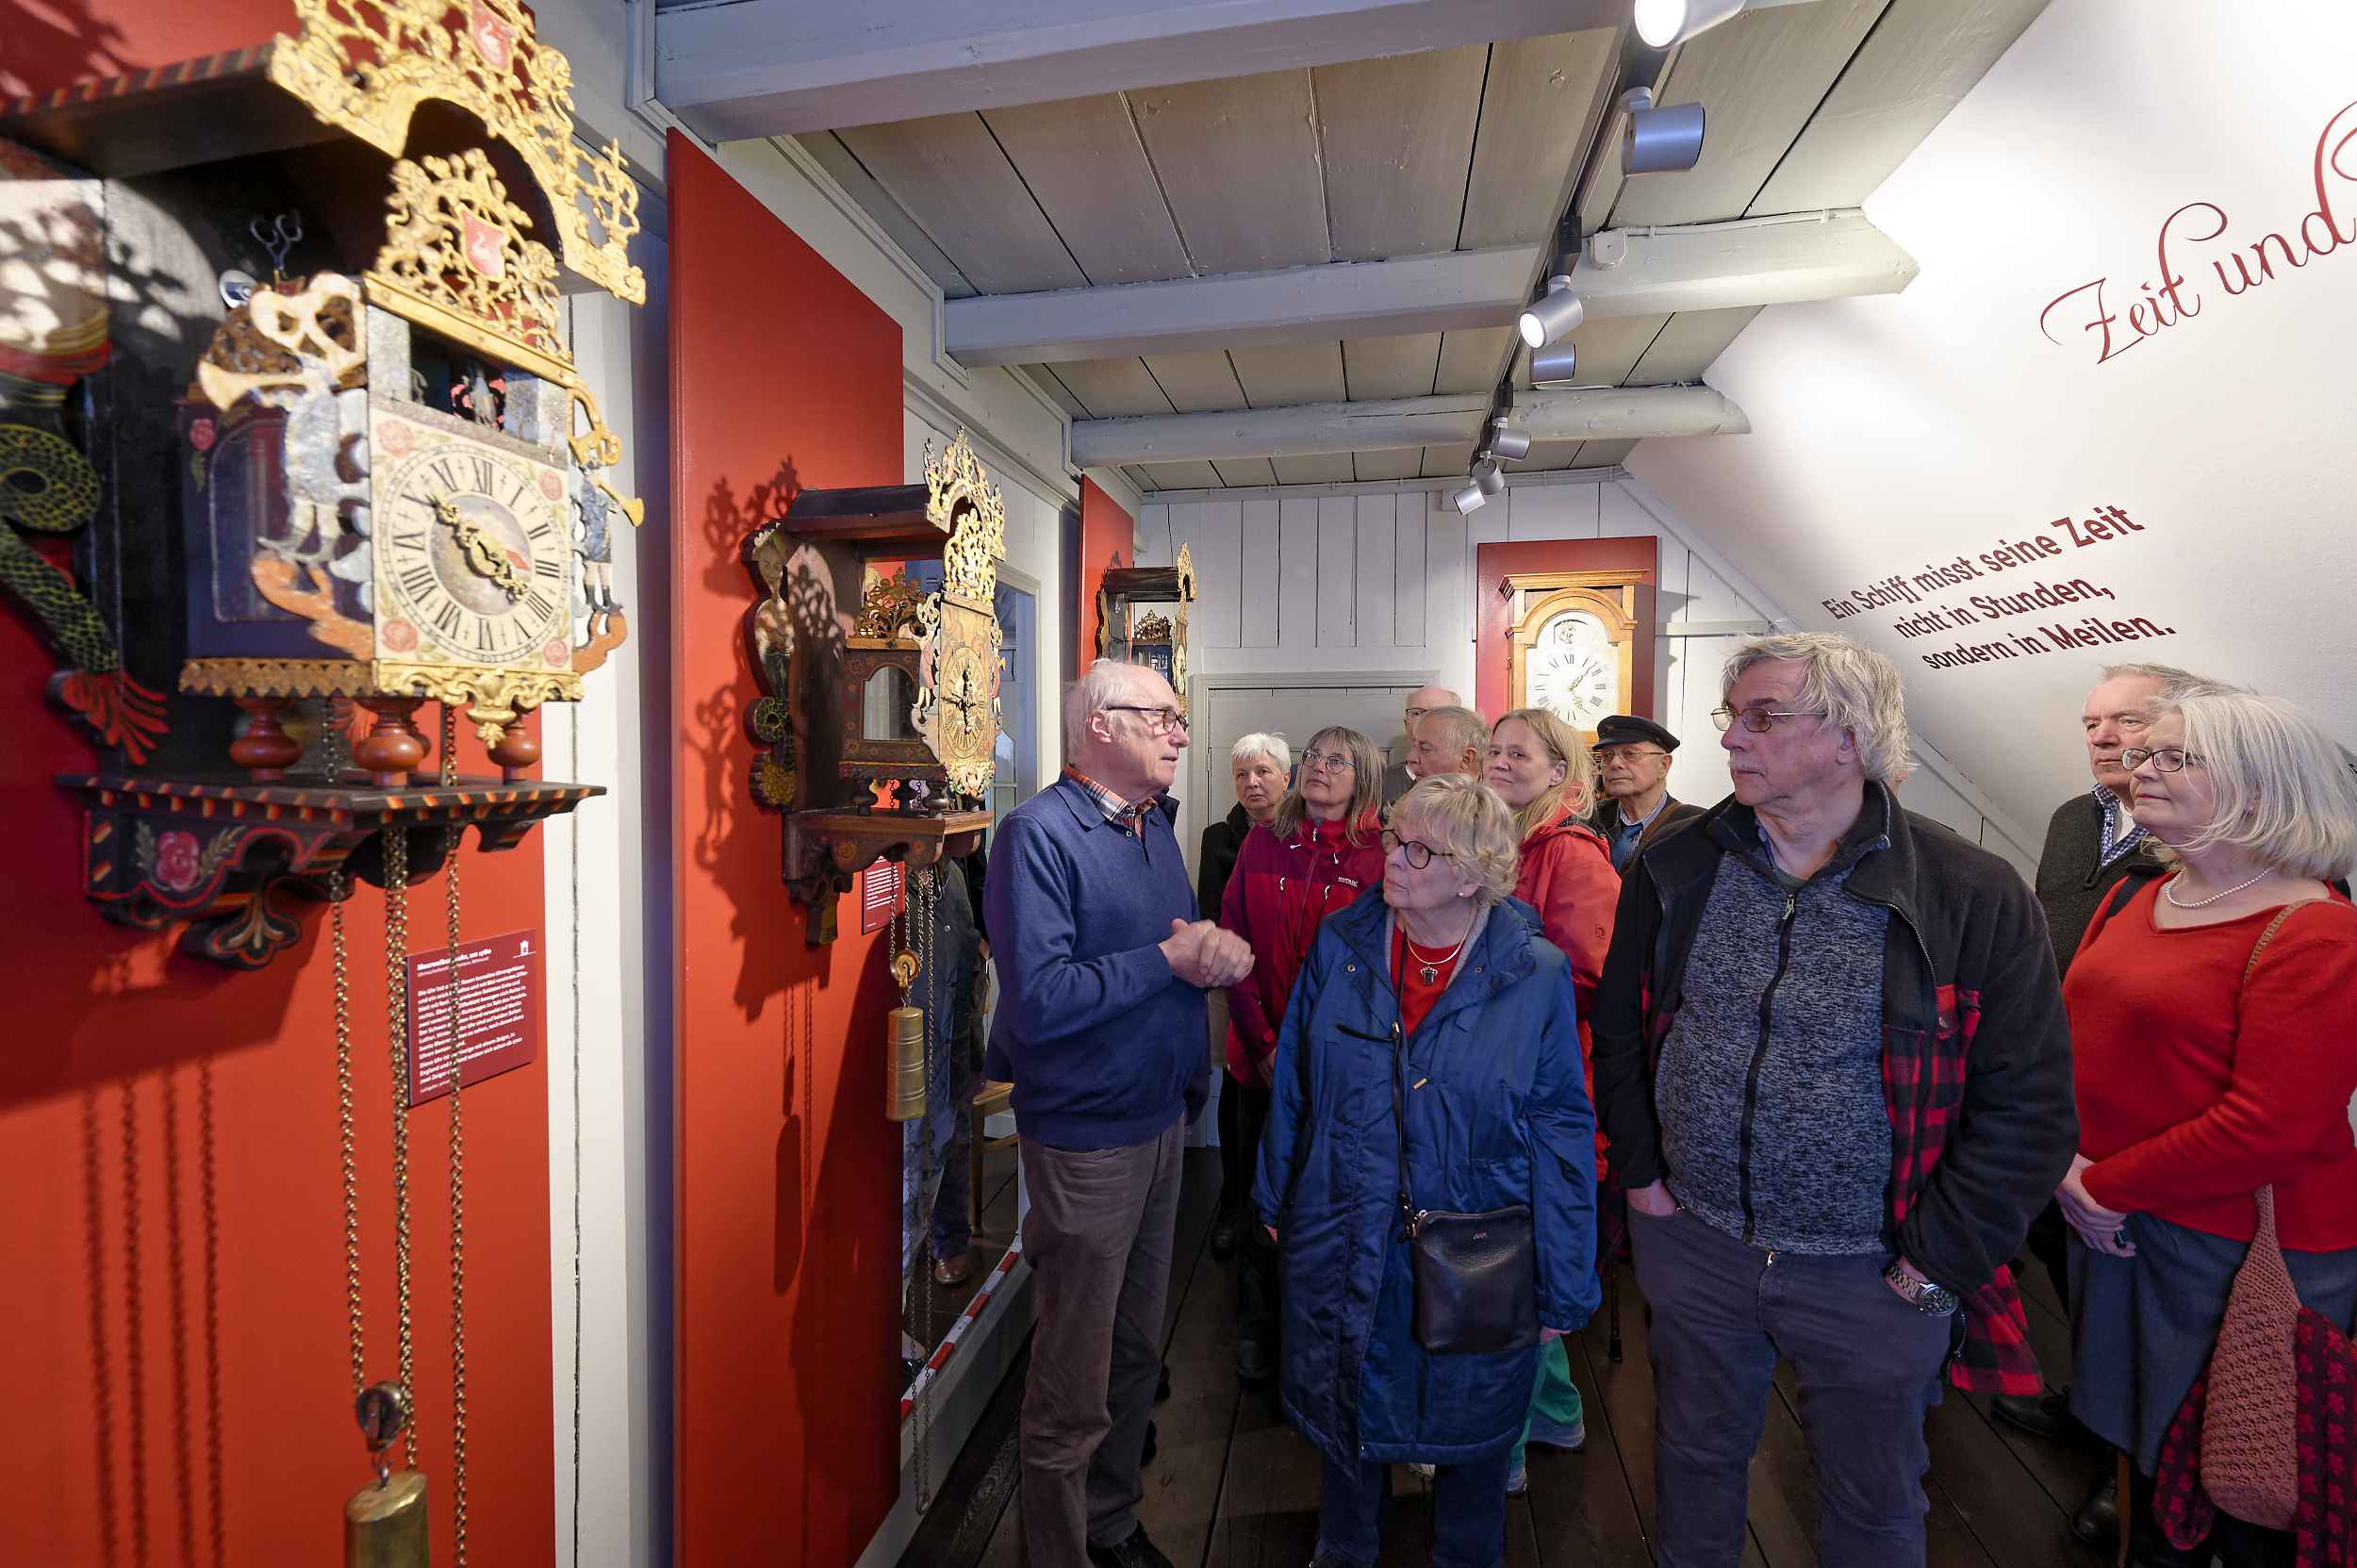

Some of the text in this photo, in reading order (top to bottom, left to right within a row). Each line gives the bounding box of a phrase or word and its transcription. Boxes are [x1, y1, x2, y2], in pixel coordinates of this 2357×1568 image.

[2040, 100, 2357, 365] Zeit und
[1821, 504, 2147, 619] Ein Schiff misst seine Zeit
[1893, 578, 2116, 638] nicht in Stunden,
[1922, 617, 2178, 670] sondern in Meilen.
